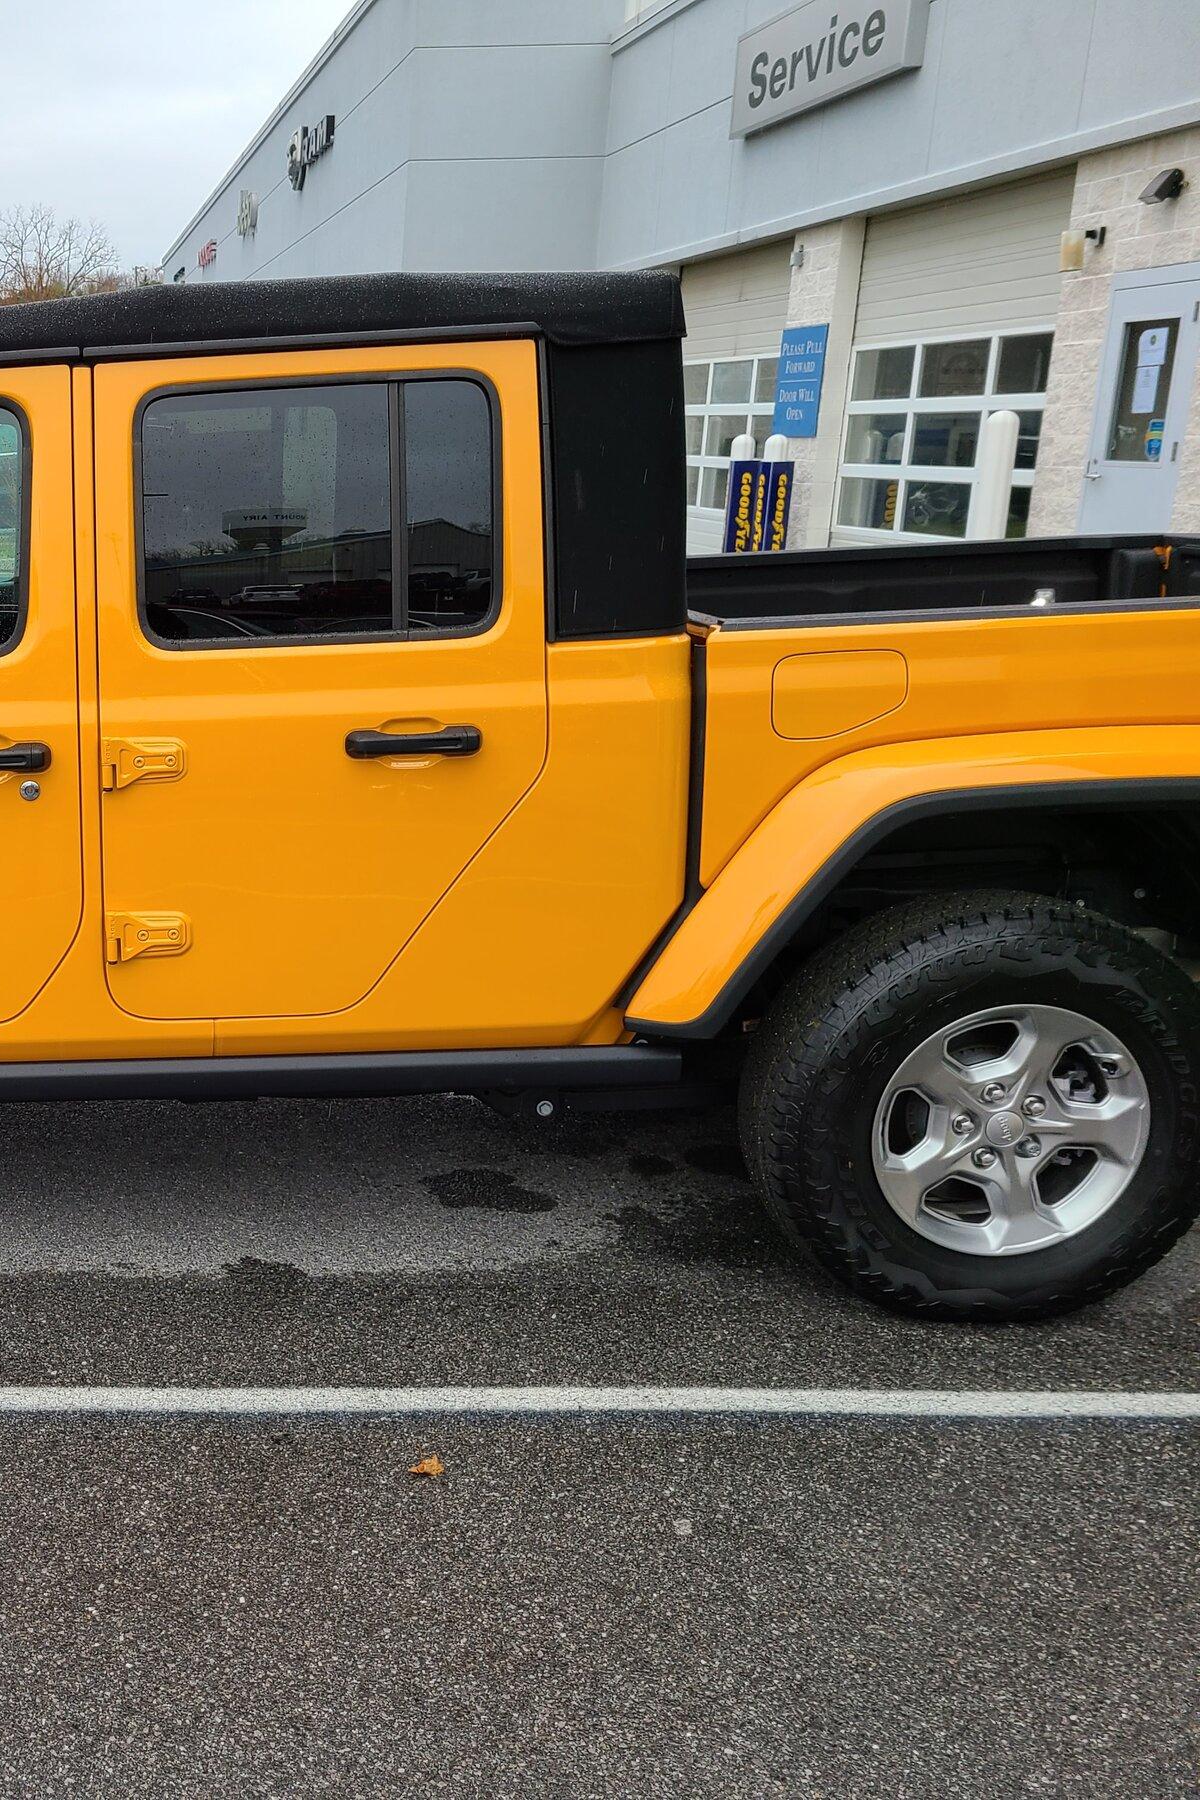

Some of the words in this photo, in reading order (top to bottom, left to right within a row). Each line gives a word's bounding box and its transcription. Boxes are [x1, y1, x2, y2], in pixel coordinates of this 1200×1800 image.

[748, 9, 886, 109] Service
[782, 342, 806, 356] PLEASE
[806, 340, 823, 354] PULL
[785, 360, 816, 374] FORWARD
[779, 389, 798, 402] DOOR
[798, 387, 815, 402] WILL
[786, 407, 803, 420] OPEN
[735, 472, 752, 553] GOODYE
[752, 474, 766, 552] GOODYE
[771, 473, 788, 552] GOODYE
